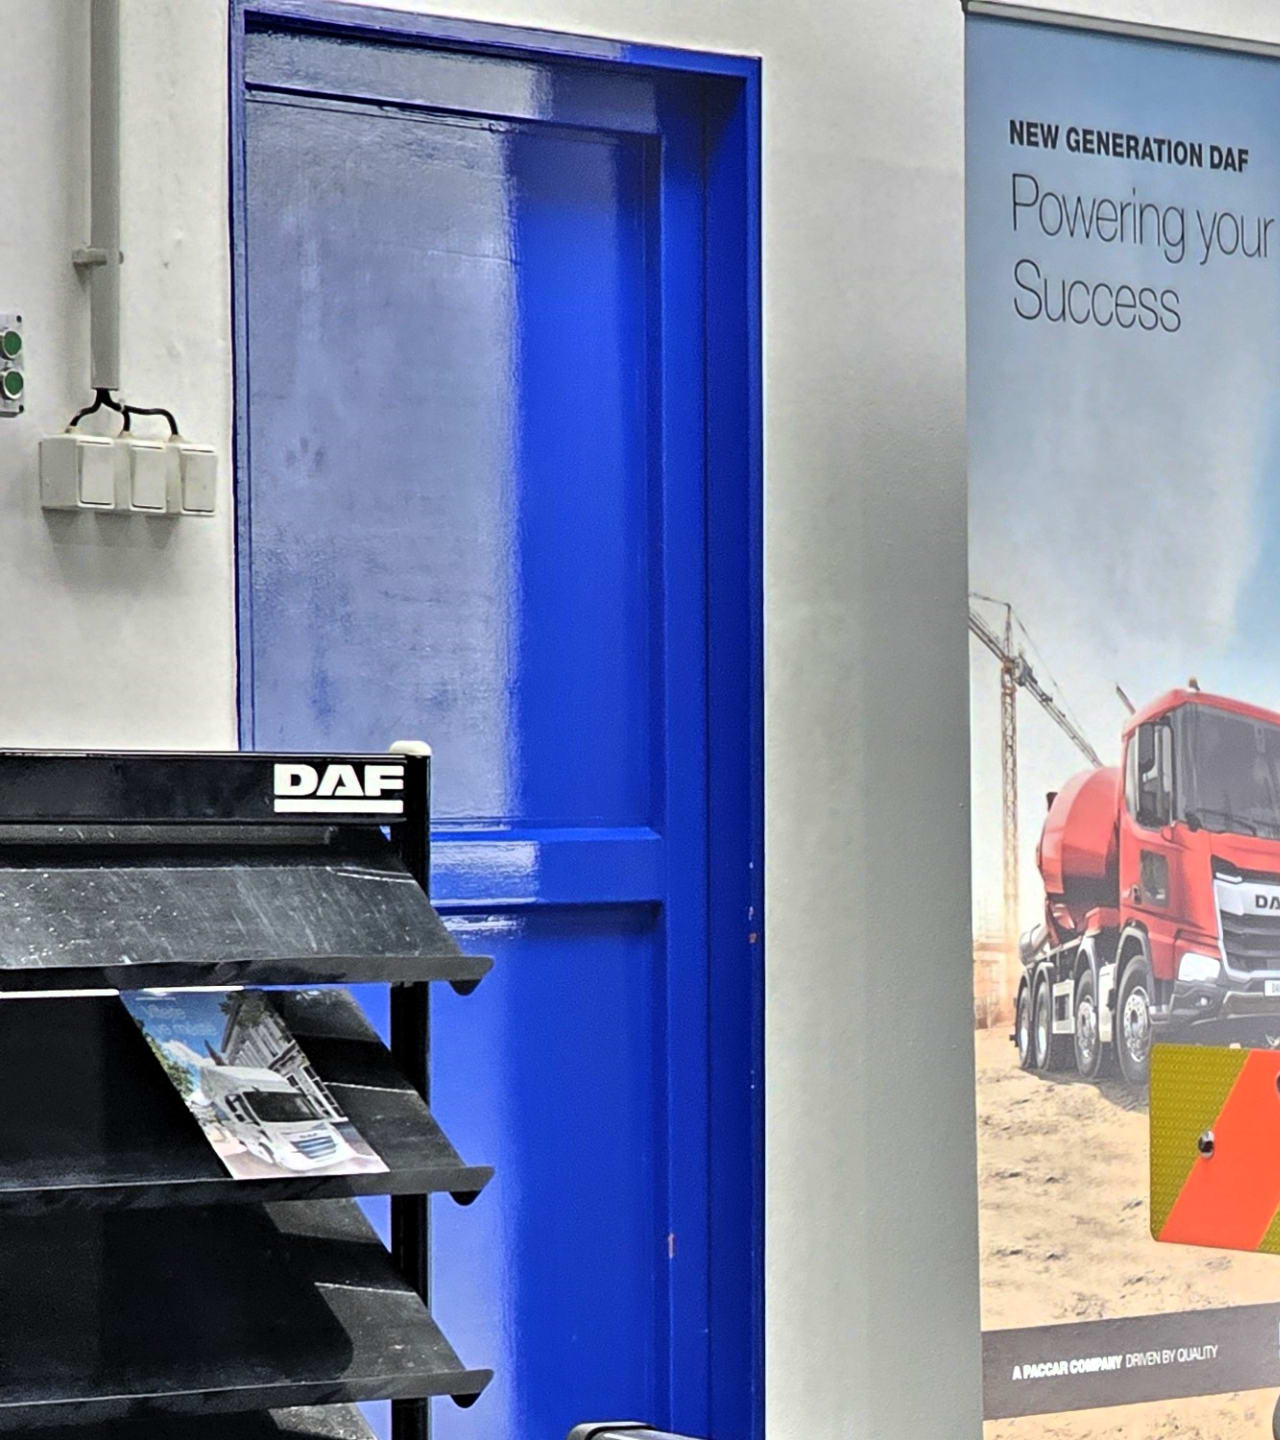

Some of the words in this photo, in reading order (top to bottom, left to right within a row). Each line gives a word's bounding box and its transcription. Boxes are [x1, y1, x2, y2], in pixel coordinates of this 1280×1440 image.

[1009, 119, 1059, 149] NEW
[1066, 126, 1202, 168] GENERATION
[1210, 145, 1249, 173] DAF
[1012, 173, 1185, 264] Powering
[1196, 209, 1275, 265] your
[1013, 259, 1181, 332] Success
[274, 763, 404, 796] DAF
[1012, 1365, 1023, 1380] A
[1023, 1360, 1068, 1378] PACCAR
[1069, 1355, 1123, 1375] COMPANY
[1125, 1350, 1161, 1368] DRIVEN
[1162, 1348, 1177, 1363] BY
[1178, 1345, 1218, 1362] QUALITY
